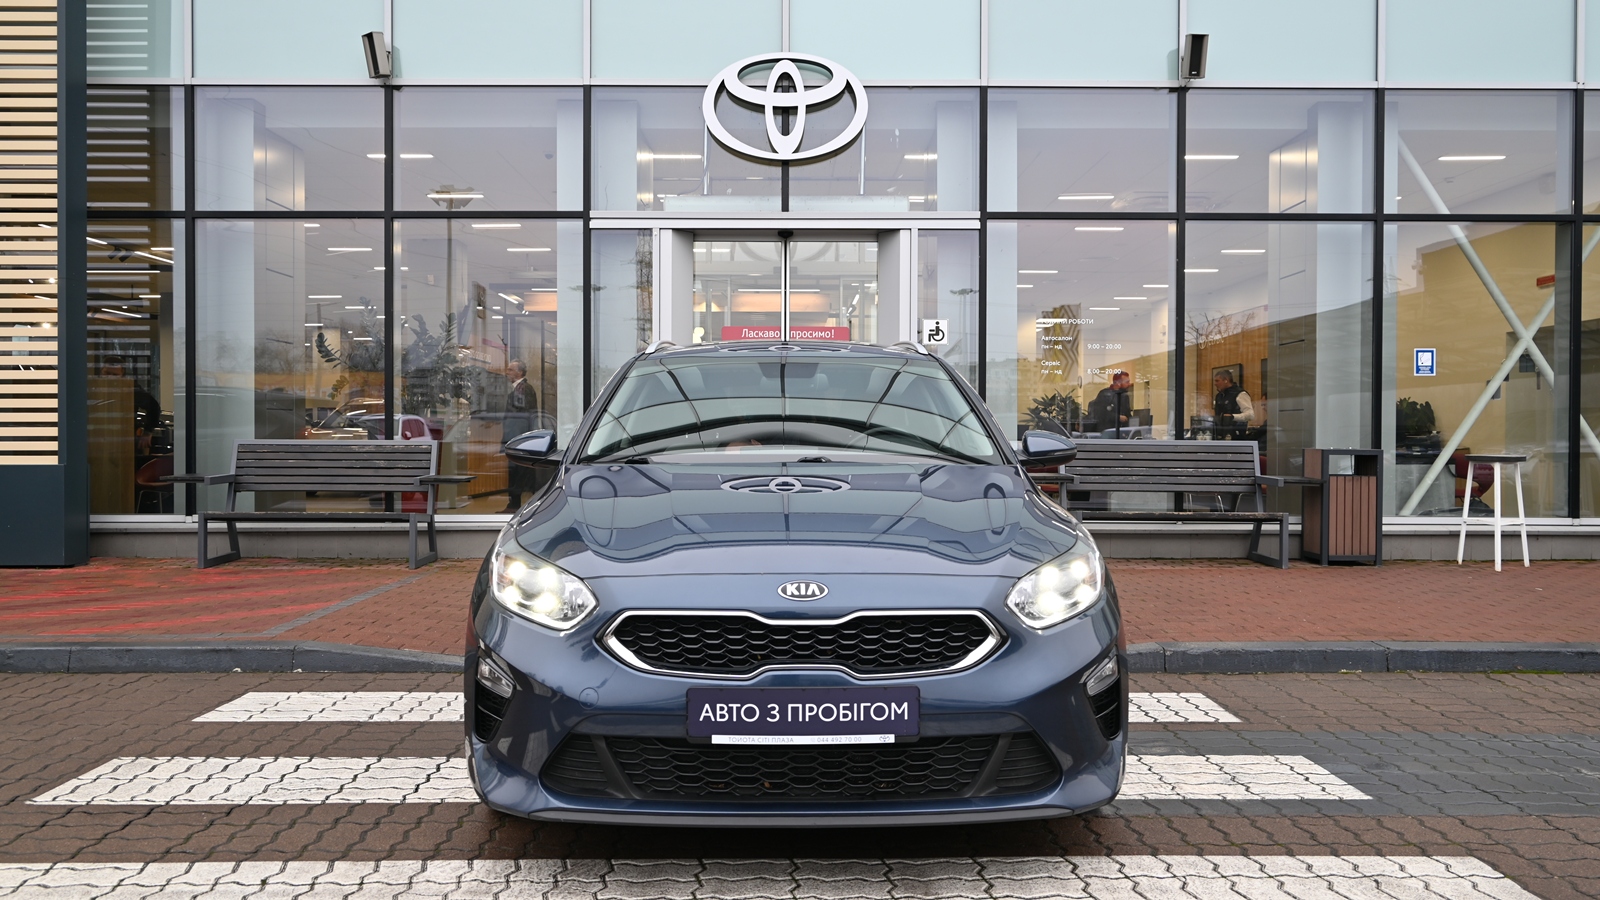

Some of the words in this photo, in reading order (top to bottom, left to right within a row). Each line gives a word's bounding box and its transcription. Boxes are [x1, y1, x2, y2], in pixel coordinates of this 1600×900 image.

[741, 328, 780, 338] Ласкаво
[791, 329, 835, 339] просимо!
[786, 583, 820, 596] KIA
[699, 703, 760, 722] АВТО
[787, 702, 909, 722] ПРОБІГОМ
